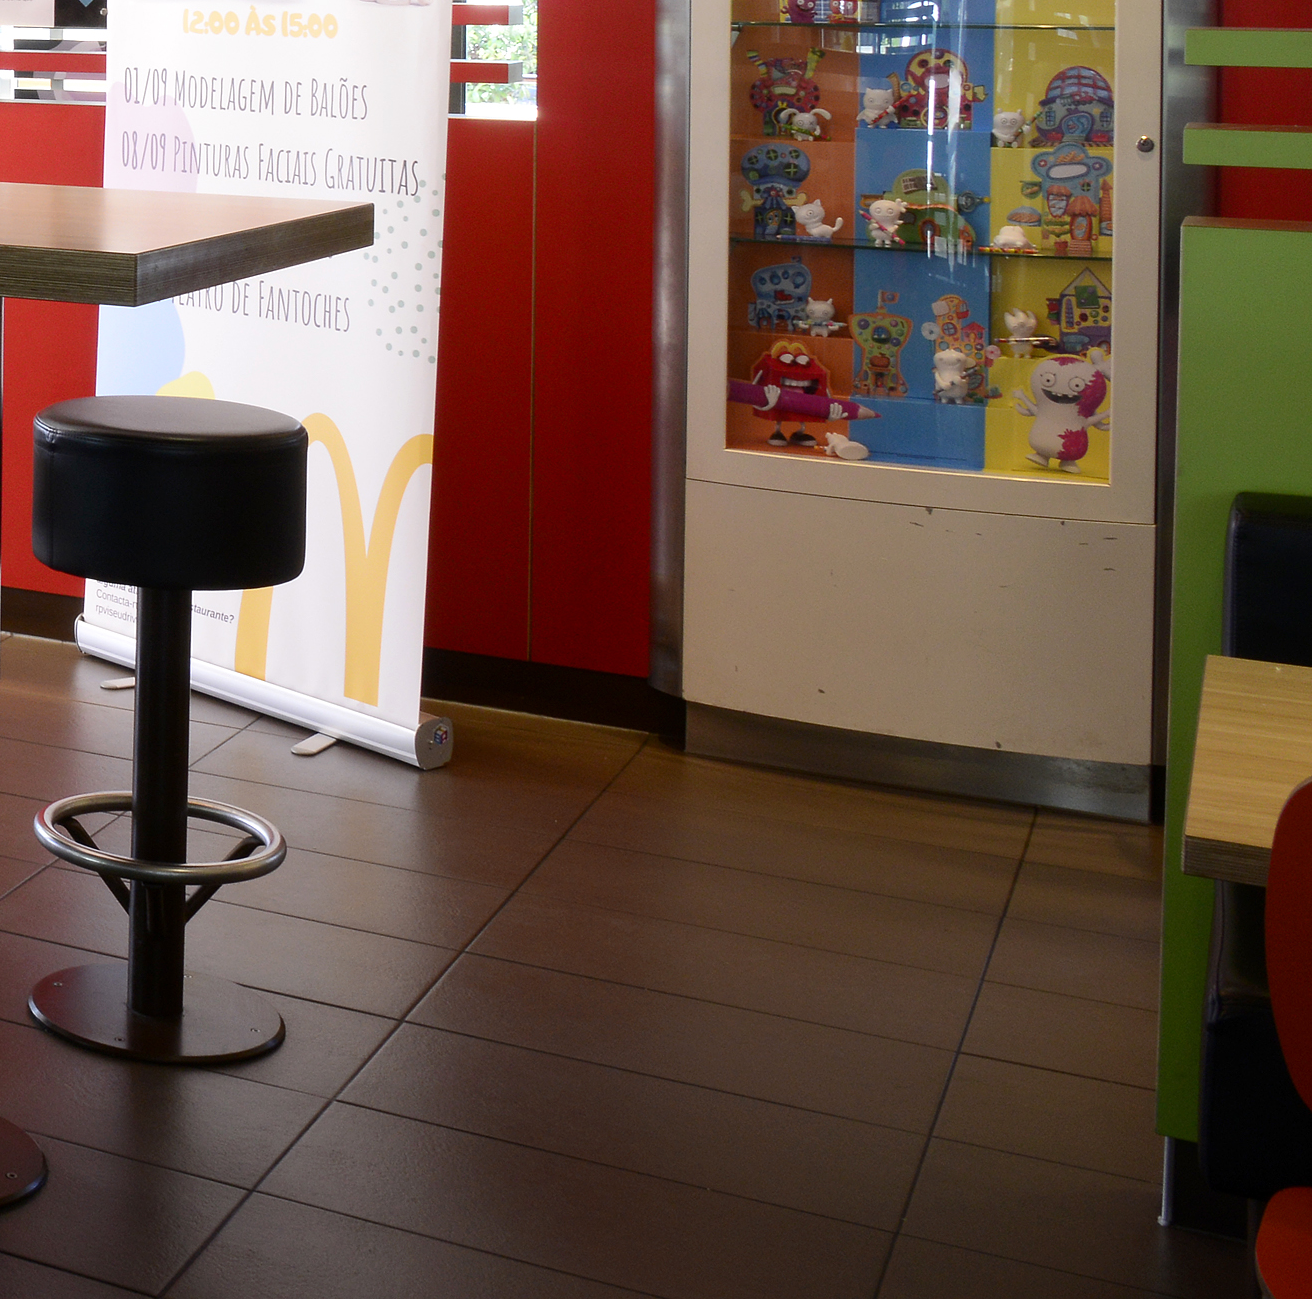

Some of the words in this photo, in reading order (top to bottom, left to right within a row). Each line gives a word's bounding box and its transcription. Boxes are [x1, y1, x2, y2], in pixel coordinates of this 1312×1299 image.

[182, 8, 240, 35] 12:00
[281, 11, 338, 39] 15:00
[124, 67, 168, 107] 01/09
[174, 70, 275, 116] MODELAGEM
[283, 80, 302, 116] DE
[310, 77, 368, 120] BALÕES
[121, 130, 166, 172] 08/09
[173, 135, 250, 180] PINTURAS
[257, 142, 317, 187] FACIAIS
[325, 148, 419, 197] GRATUITAS
[232, 280, 249, 316] DE
[258, 280, 350, 332] FANTOCHES
